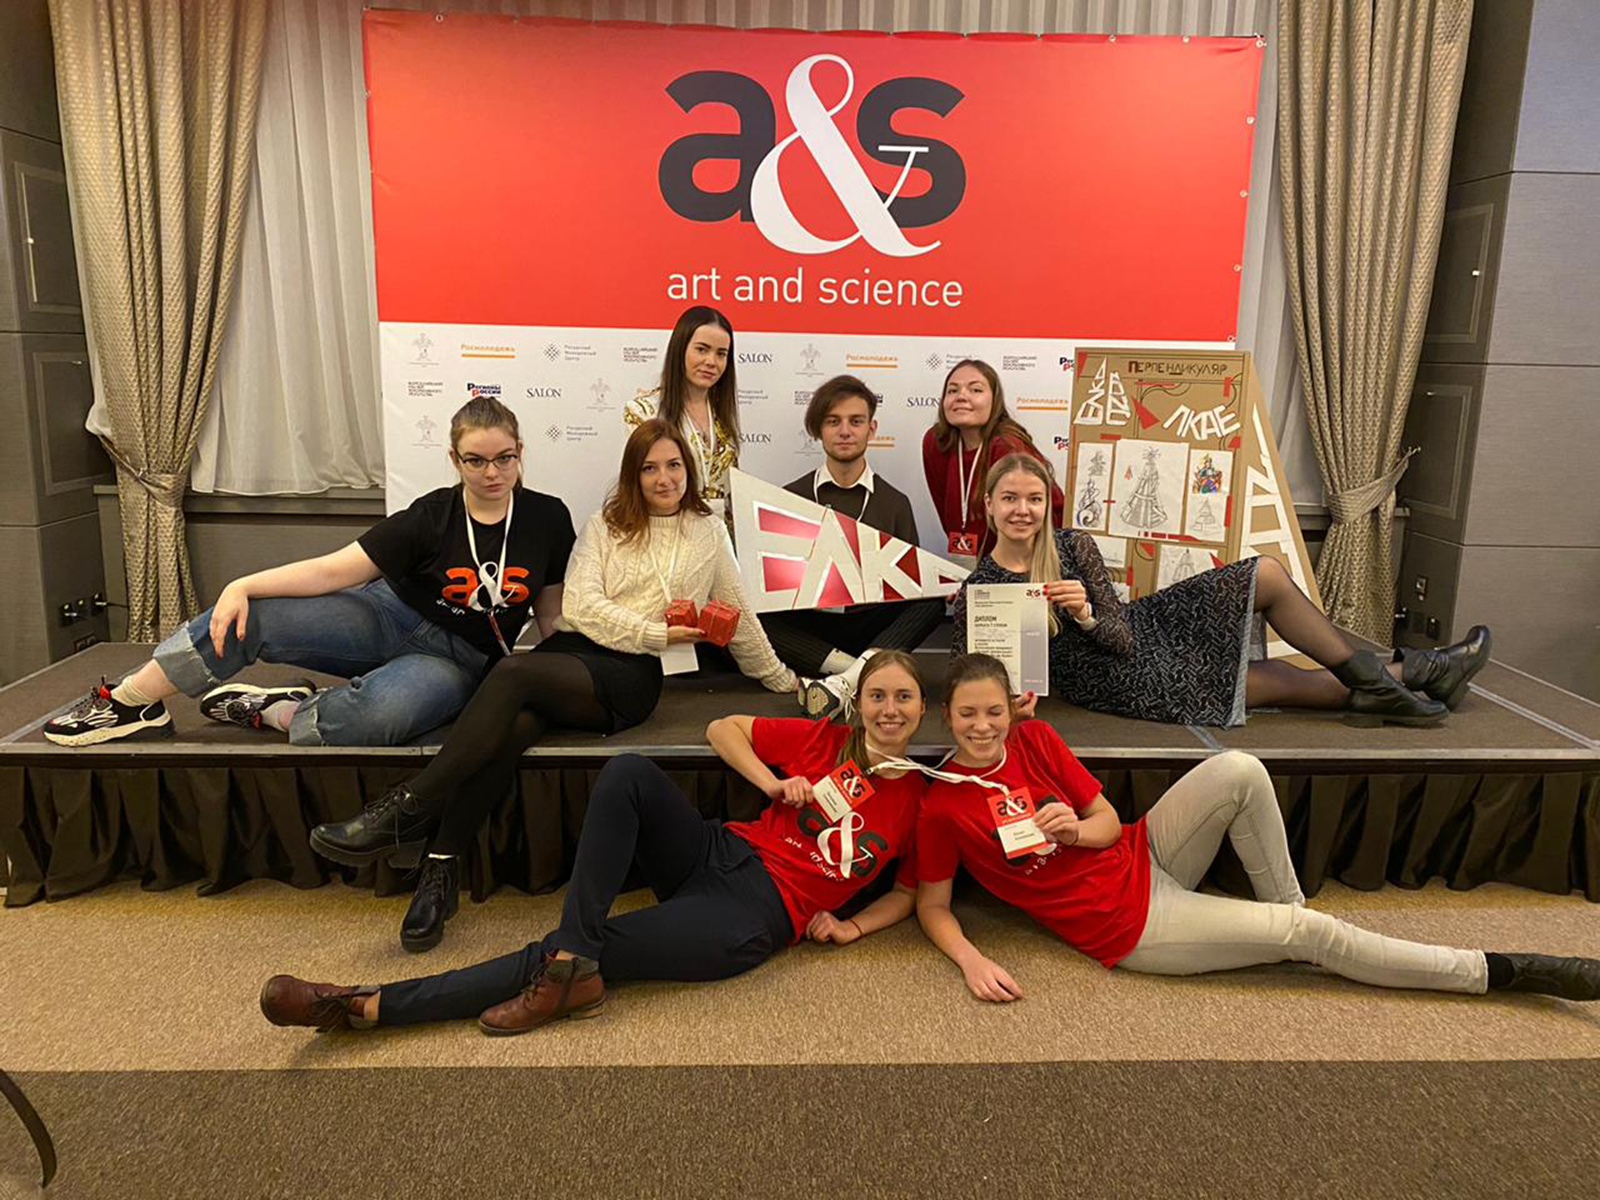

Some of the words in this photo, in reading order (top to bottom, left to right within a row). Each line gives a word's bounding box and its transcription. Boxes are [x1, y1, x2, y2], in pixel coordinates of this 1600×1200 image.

[658, 54, 967, 257] a&s
[667, 268, 720, 301] art
[733, 267, 803, 303] and
[818, 268, 963, 307] science
[738, 353, 773, 364] SALON
[526, 387, 562, 399] SALON
[906, 397, 941, 408] SALON
[739, 433, 772, 443] SALON
[442, 562, 530, 612] a&s
